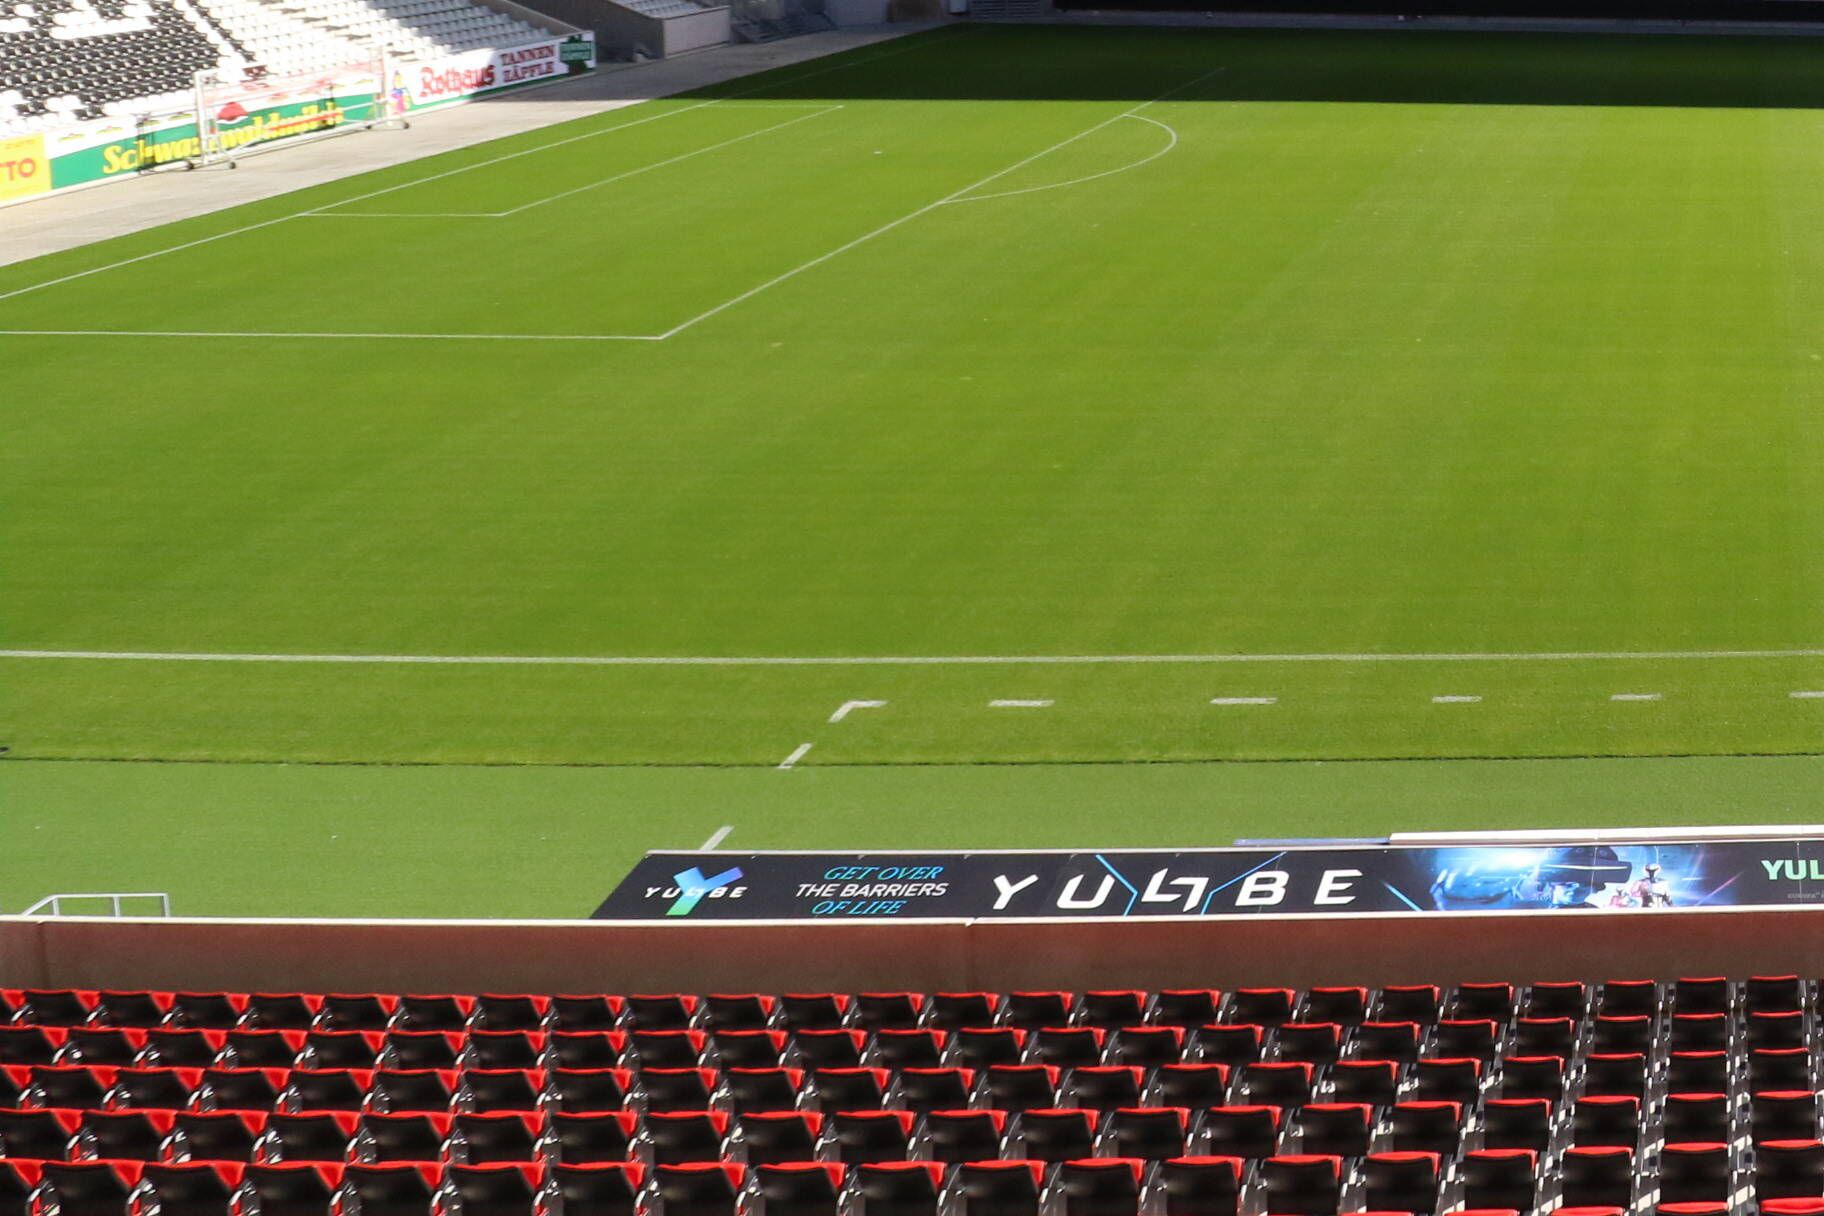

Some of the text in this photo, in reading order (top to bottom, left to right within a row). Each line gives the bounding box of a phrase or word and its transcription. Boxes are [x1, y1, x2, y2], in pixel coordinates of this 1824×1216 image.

[501, 44, 556, 66] TANNEN
[419, 64, 496, 98] Rothaus
[824, 866, 944, 880] GET OVER
[795, 883, 949, 898] THE BARRIERS
[811, 899, 907, 915] OF LIFE
